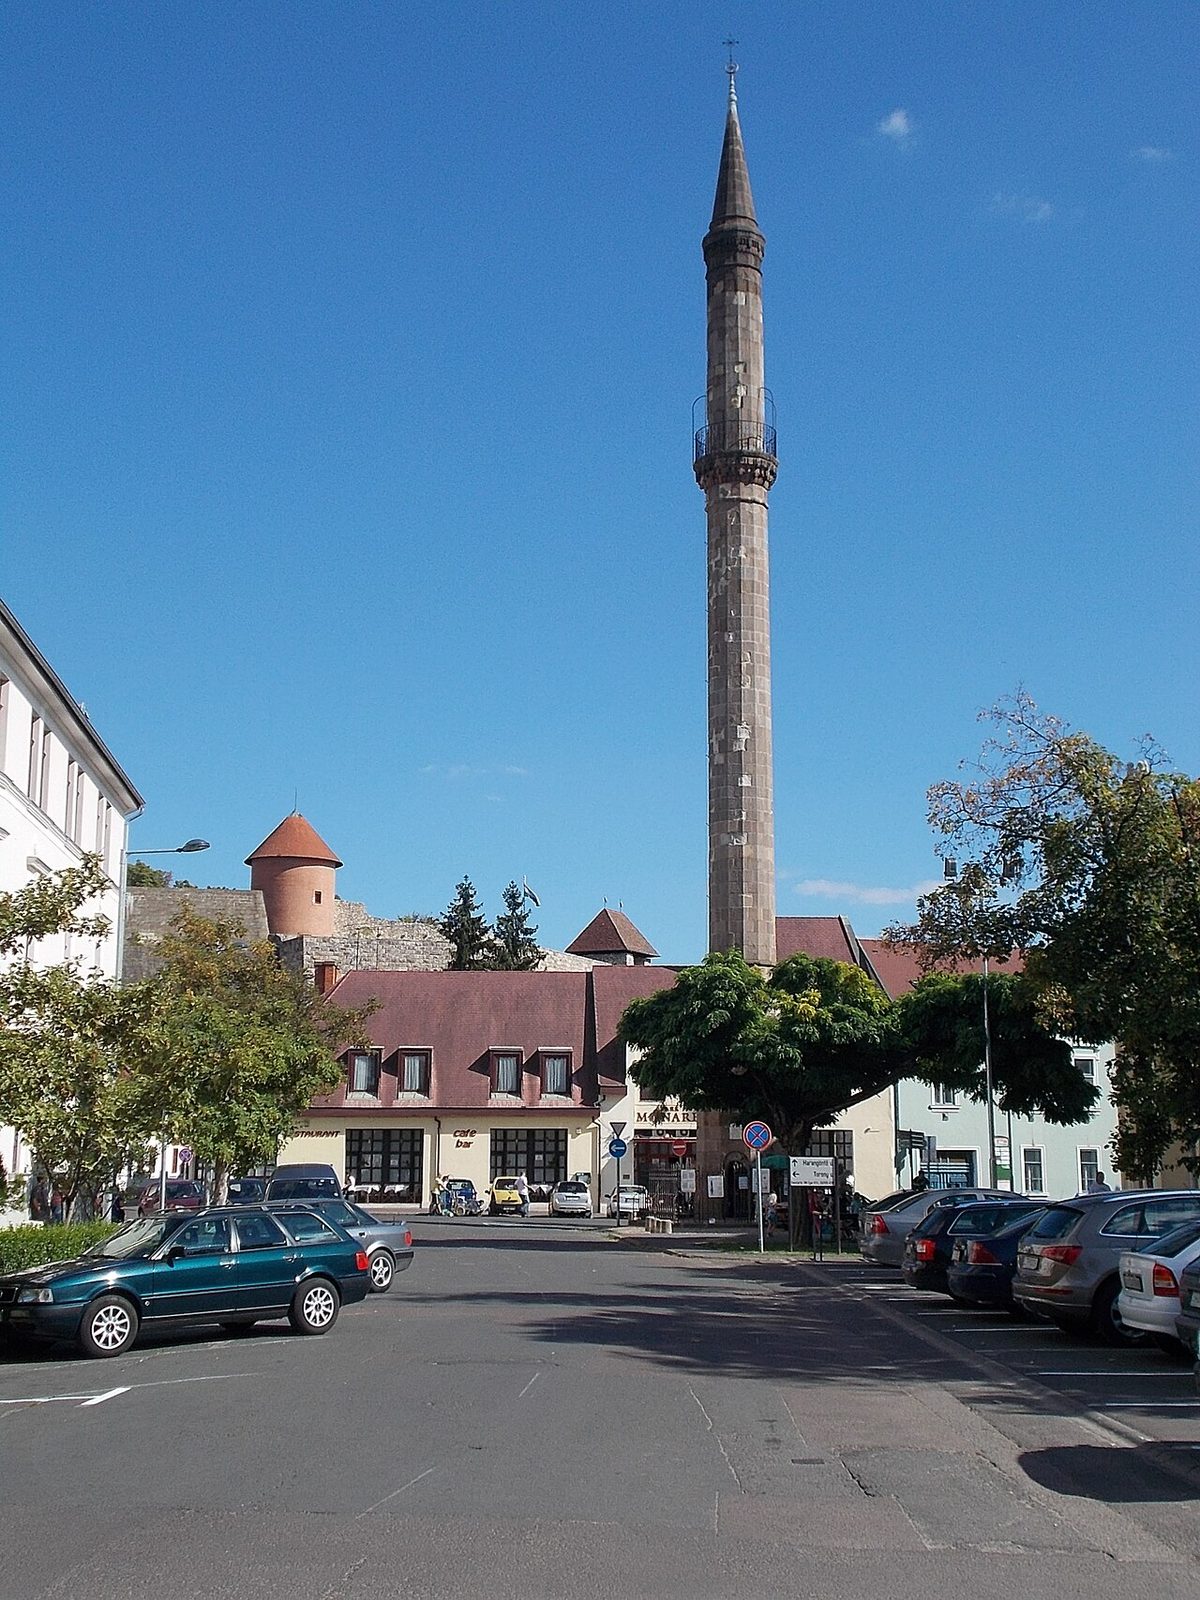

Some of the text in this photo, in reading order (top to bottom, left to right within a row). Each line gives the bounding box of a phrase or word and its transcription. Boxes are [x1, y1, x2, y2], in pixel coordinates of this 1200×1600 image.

[636, 1112, 698, 1122] MNAR
[289, 1130, 340, 1138] STAURANT
[455, 1139, 473, 1148] bar
